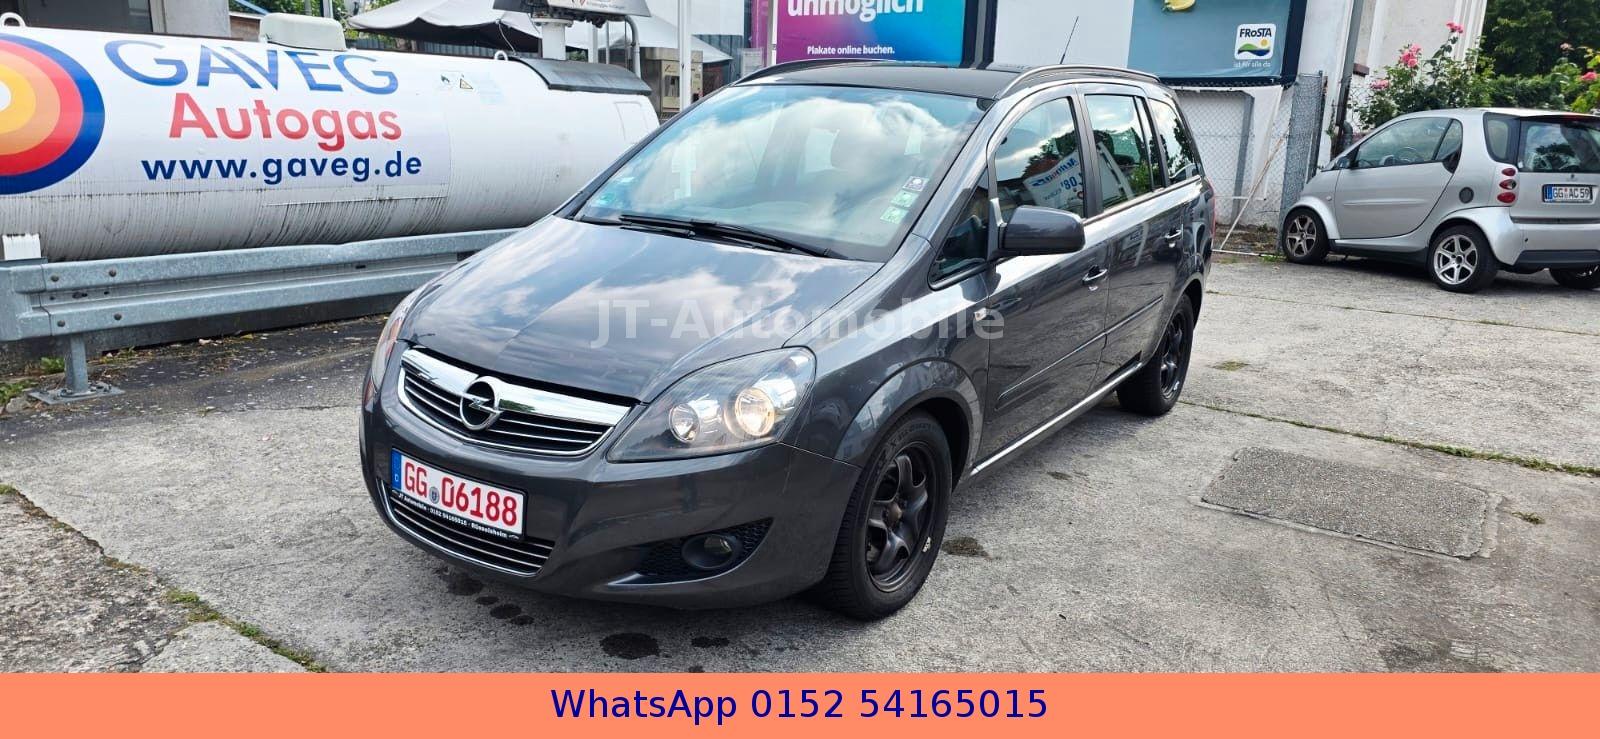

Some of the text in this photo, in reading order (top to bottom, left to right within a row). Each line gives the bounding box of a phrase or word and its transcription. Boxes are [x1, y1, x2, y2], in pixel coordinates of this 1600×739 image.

[104, 39, 399, 95] GAVEG
[807, 45, 895, 55] Plakate online buchen.
[169, 92, 402, 151] Autogas
[141, 150, 423, 185] www.gaveg.de
[1553, 188, 1563, 198] GG
[1580, 188, 1590, 198] 59
[404, 462, 517, 527] GG 06188
